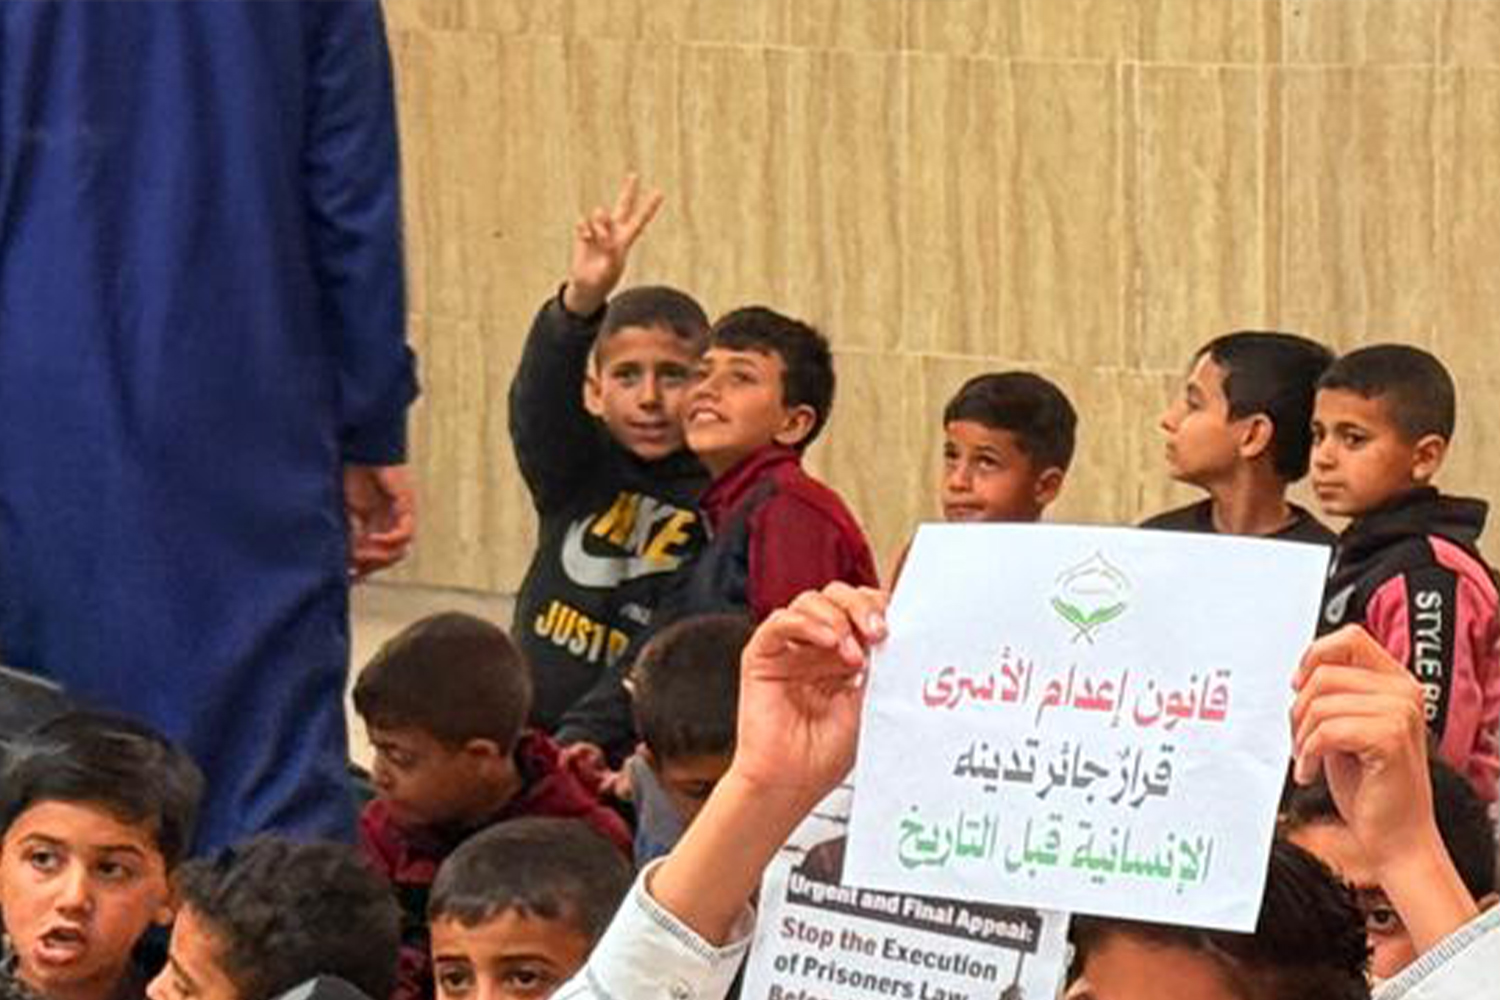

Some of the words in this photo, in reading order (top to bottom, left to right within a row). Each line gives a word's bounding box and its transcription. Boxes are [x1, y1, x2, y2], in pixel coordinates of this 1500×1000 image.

[534, 600, 607, 663] JUST
[1415, 591, 1442, 677] STYLE
[921, 646, 1033, 710] الأسرى
[1035, 663, 1128, 728] إعدام
[1133, 670, 1232, 729] قانون
[952, 738, 1039, 793] تدينه
[1036, 741, 1109, 804] جائر
[897, 805, 998, 870] التاريخ
[1003, 813, 1063, 877] قبل
[1071, 820, 1213, 895] الإنسانية
[790, 873, 859, 906] Urgent
[860, 892, 900, 915] and
[902, 899, 951, 925] Final
[956, 909, 1035, 943] Appeal:
[774, 953, 799, 975] of
[802, 956, 915, 1000] Prisoners
[781, 917, 835, 951] Stop
[839, 928, 877, 956] the
[881, 938, 998, 982] Execution
